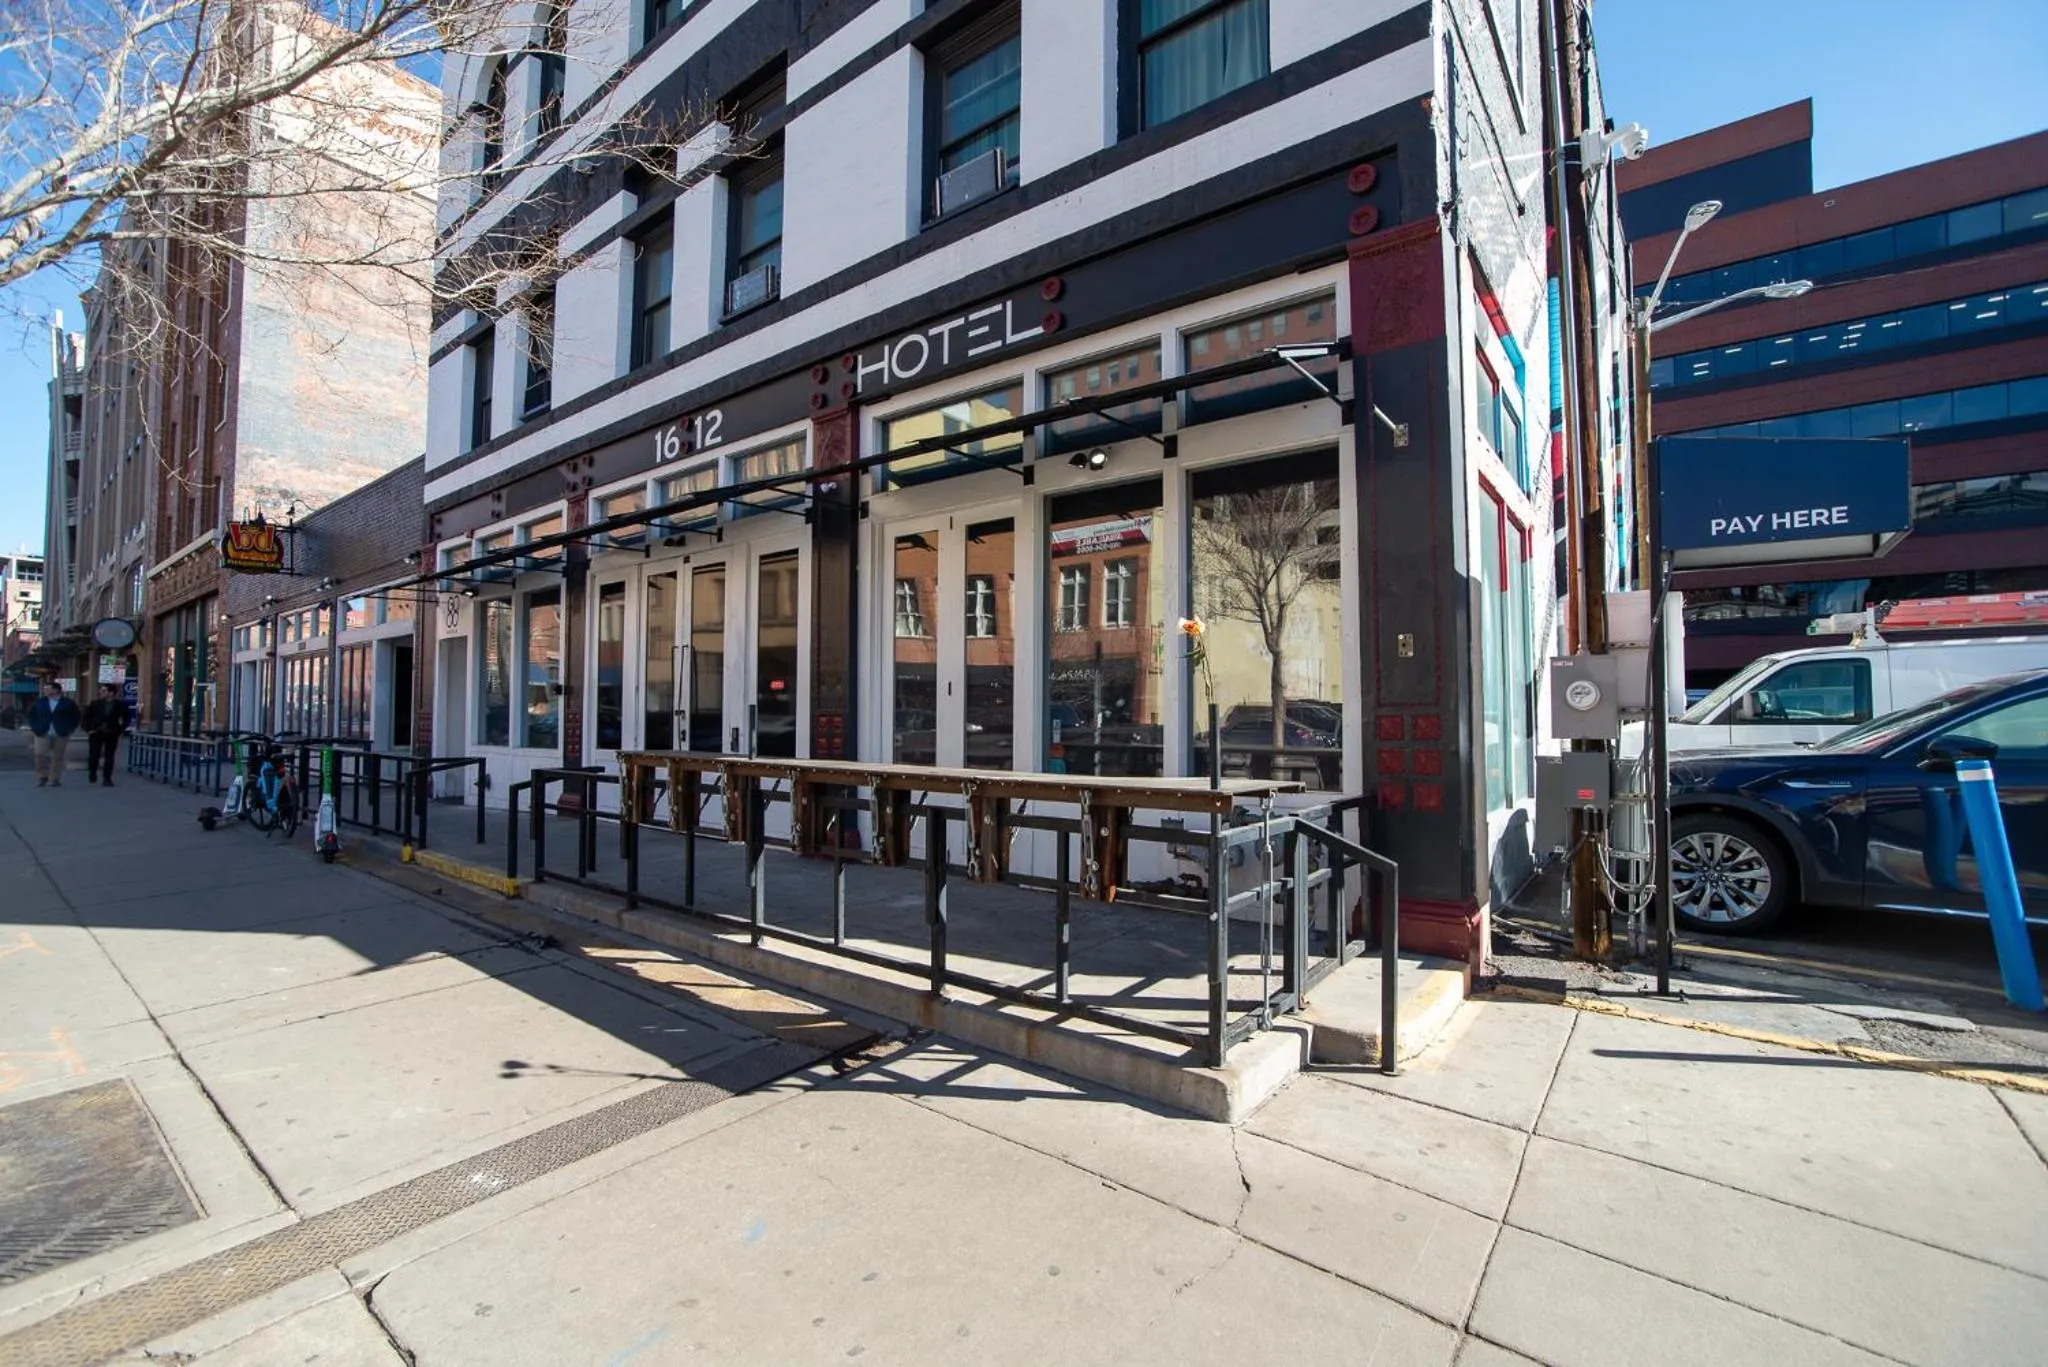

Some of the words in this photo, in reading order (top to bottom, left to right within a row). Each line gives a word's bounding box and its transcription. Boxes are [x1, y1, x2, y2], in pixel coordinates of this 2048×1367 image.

[857, 299, 1045, 393] HOTEL
[1711, 514, 1764, 536] PAY
[1771, 505, 1849, 530] HERE
